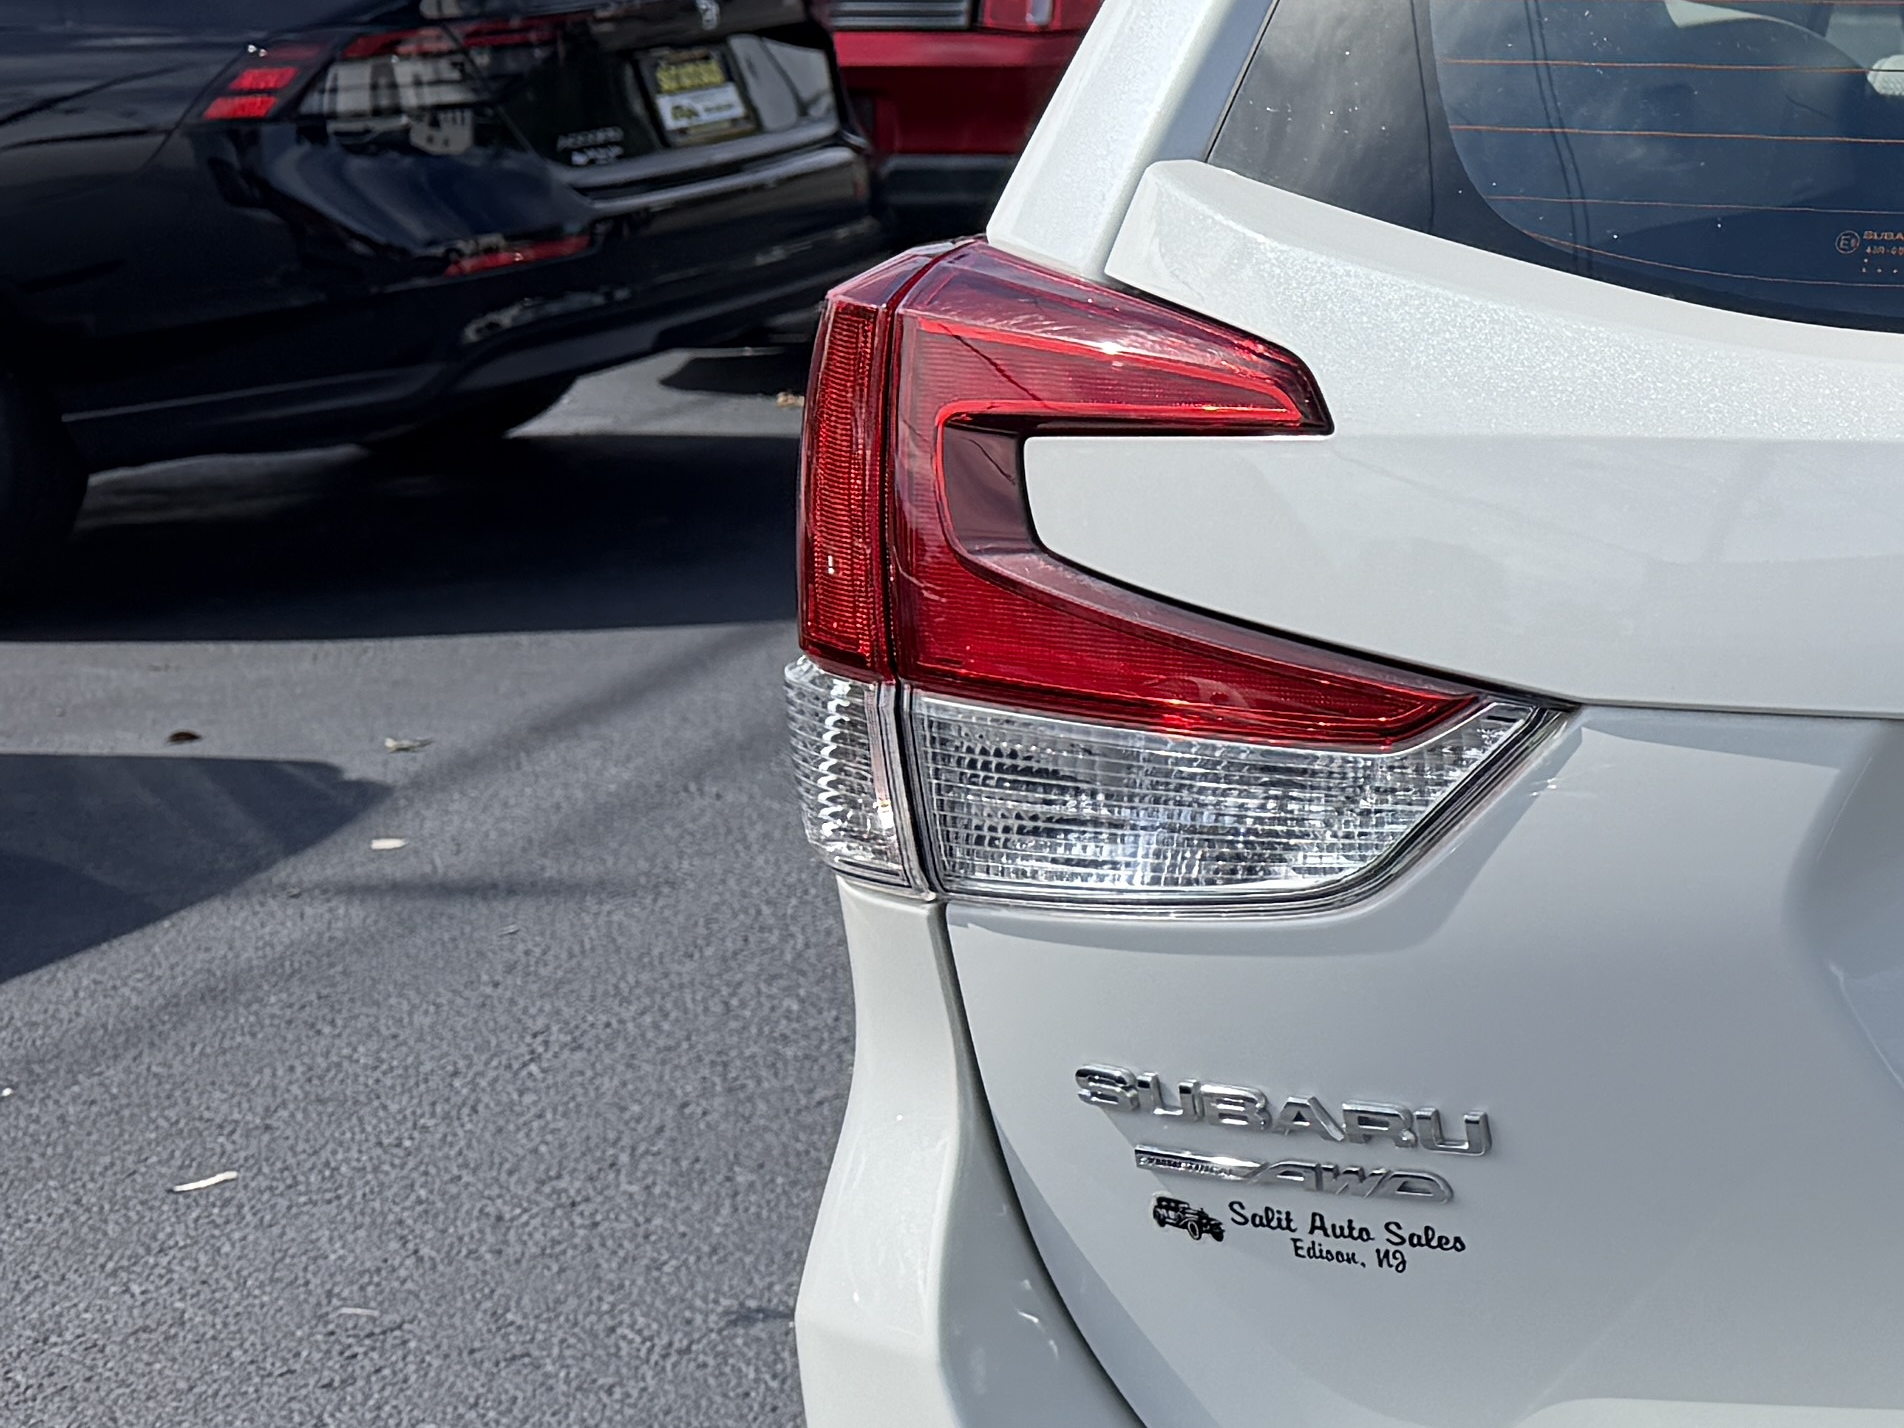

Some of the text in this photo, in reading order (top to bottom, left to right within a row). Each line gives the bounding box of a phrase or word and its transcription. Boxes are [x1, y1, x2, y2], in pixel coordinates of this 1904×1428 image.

[1075, 1062, 1492, 1157] SUBARU
[1246, 1157, 1455, 1204] AWD
[1228, 1200, 1467, 1252] Salit Auto Sales
[1291, 1237, 1408, 1273] Edison, NJ
